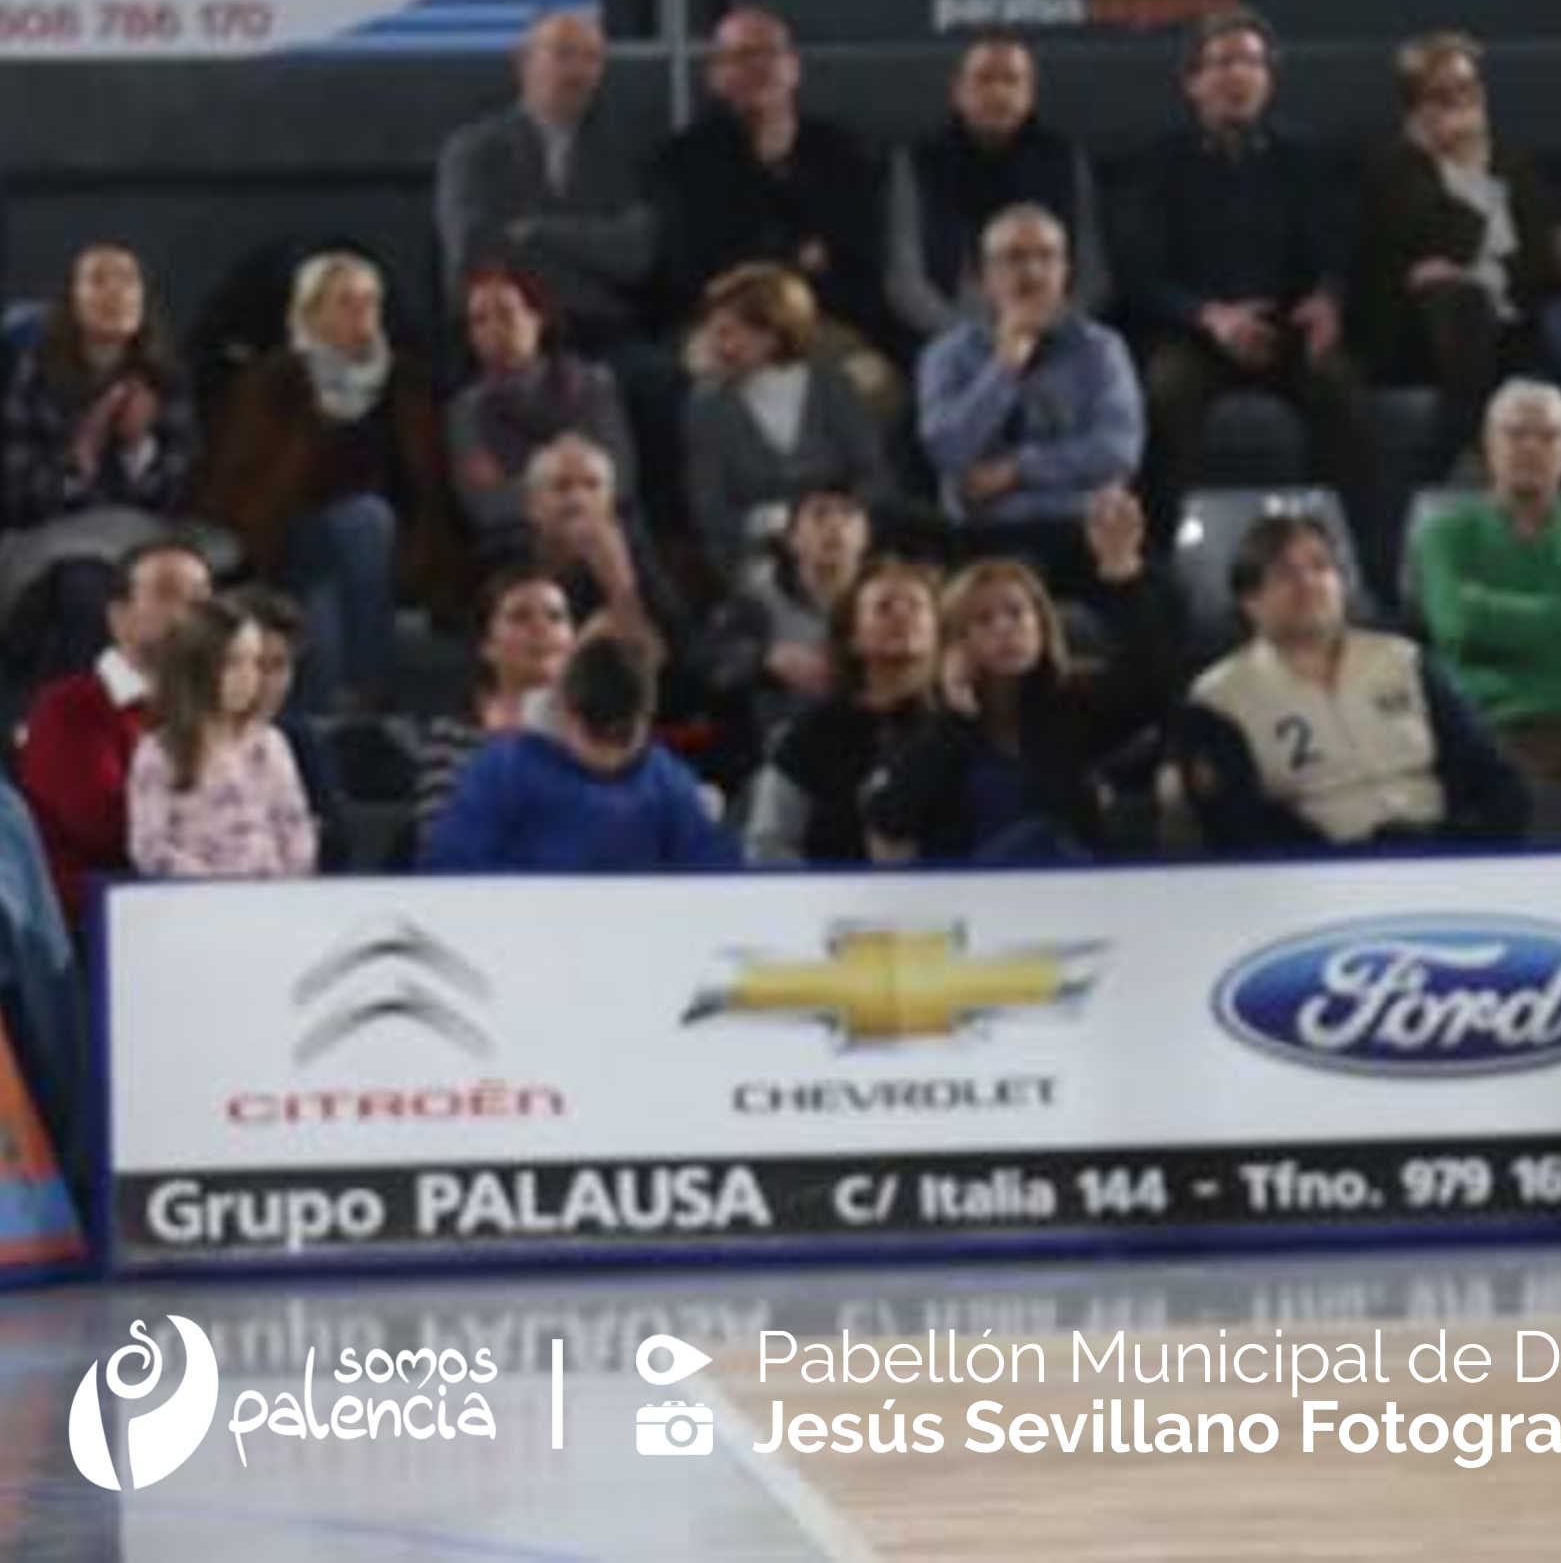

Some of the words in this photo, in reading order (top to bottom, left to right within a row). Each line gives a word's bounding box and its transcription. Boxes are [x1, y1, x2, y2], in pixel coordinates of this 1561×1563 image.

[732, 1076, 1058, 1118] CHEVROLET
[146, 1176, 386, 1255] Grupo
[416, 1162, 772, 1234] PALAUSA
[834, 1174, 898, 1221] C/
[918, 1168, 1056, 1221] Italia
[1076, 1166, 1168, 1214] 144
[1239, 1161, 1383, 1211] Tfno.
[1402, 1160, 1492, 1206] 979
